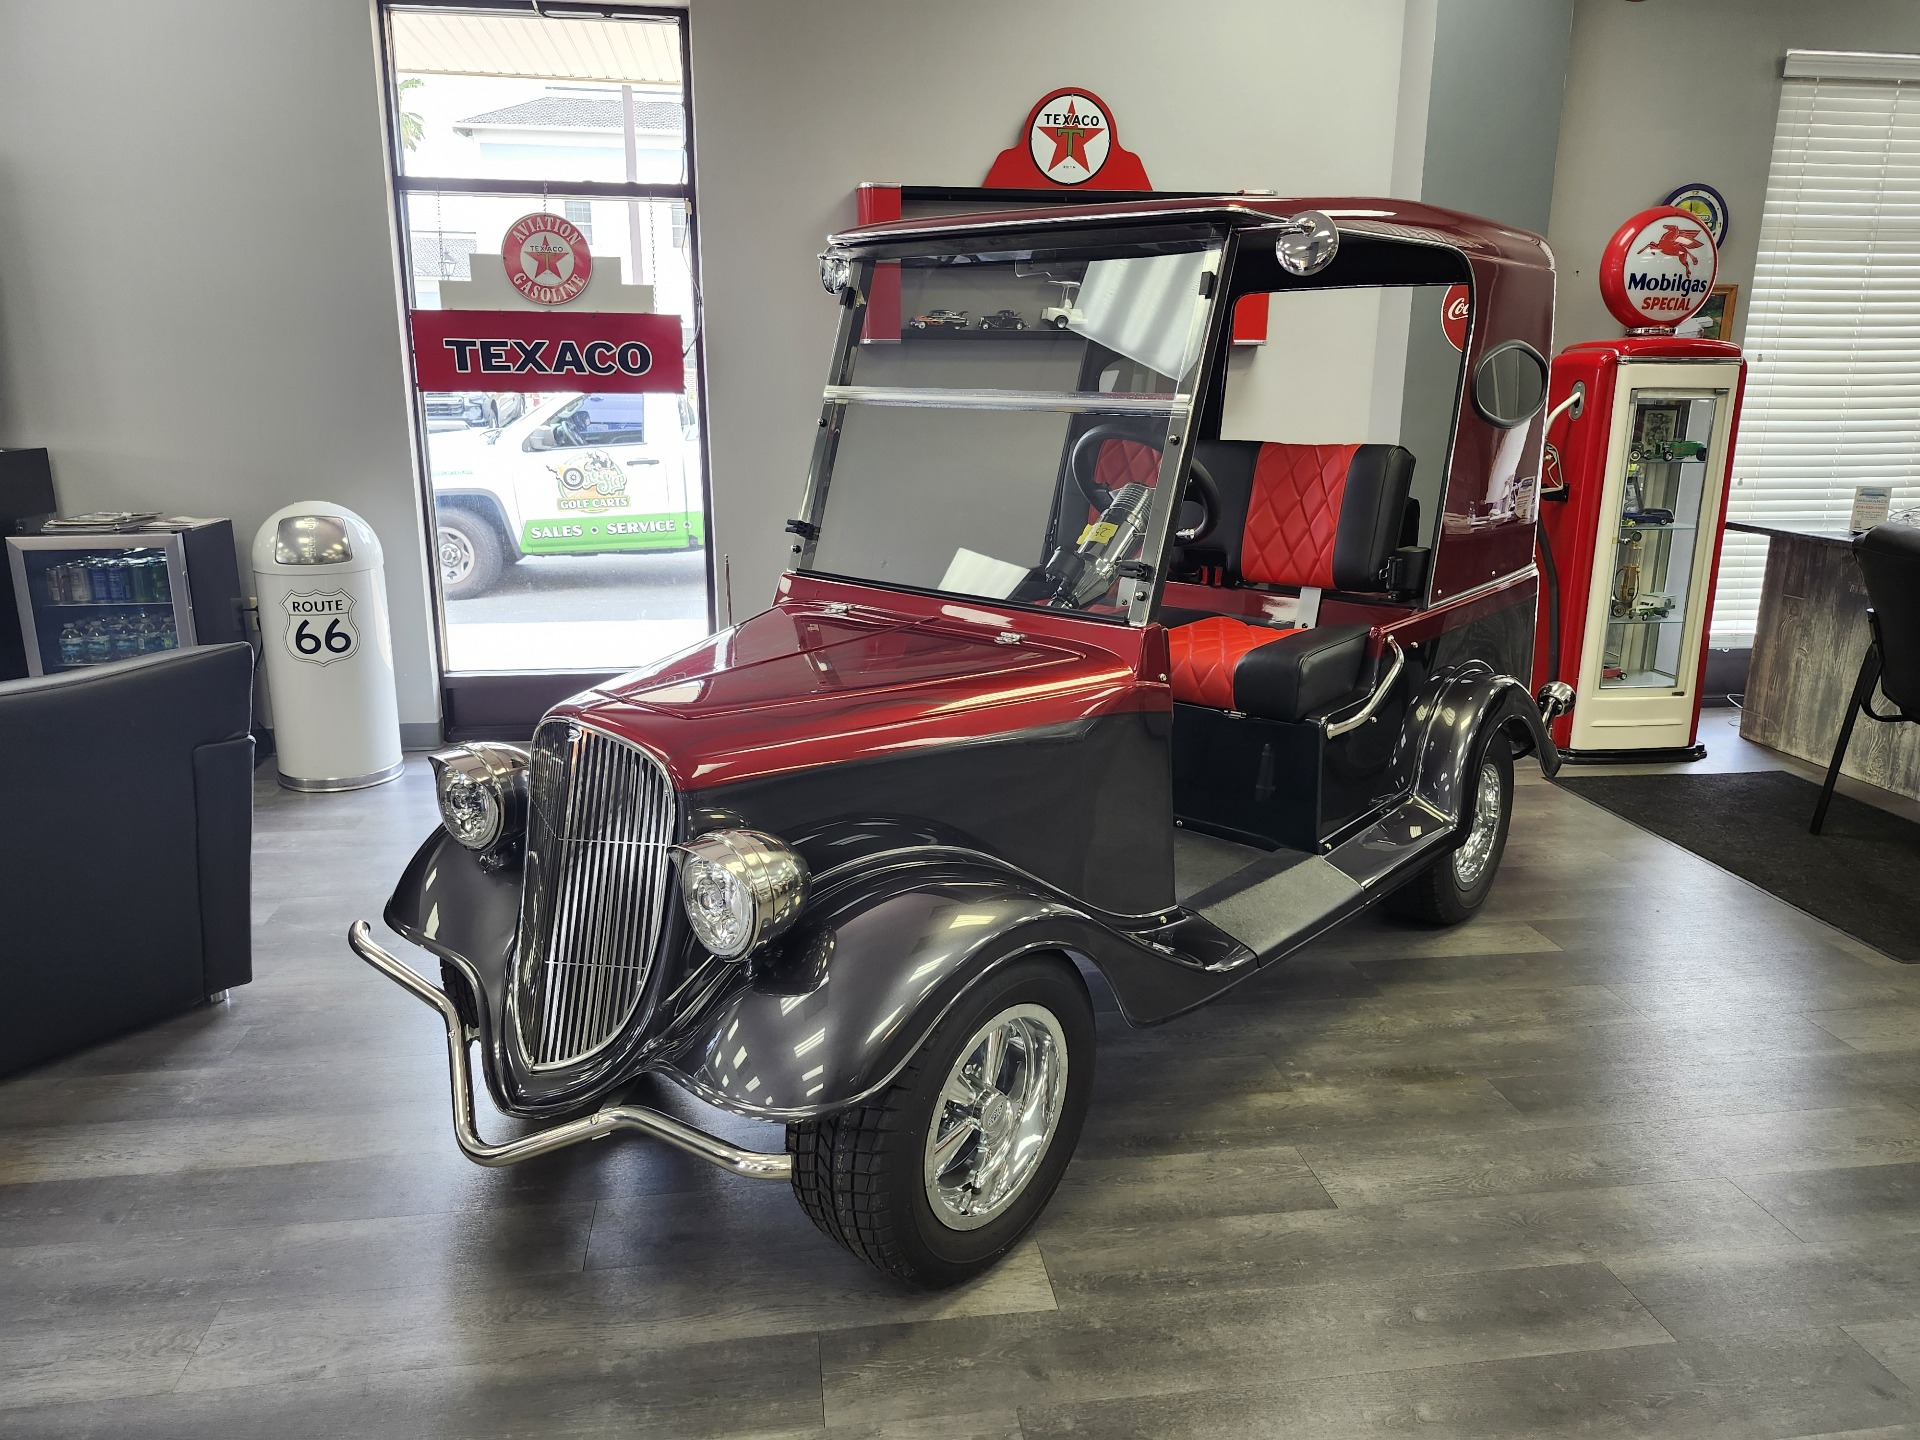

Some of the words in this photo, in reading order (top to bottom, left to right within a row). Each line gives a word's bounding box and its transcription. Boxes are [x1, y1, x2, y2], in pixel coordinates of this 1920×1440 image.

[1044, 113, 1100, 126] TEXACO
[1057, 128, 1085, 157] T
[512, 216, 583, 245] AVIATION
[530, 245, 564, 253] TEXACO
[513, 272, 586, 302] GASOLINE
[1628, 272, 1707, 297] Mobilgas
[1641, 297, 1691, 311] SPECIAL
[443, 338, 653, 376] TEXACO
[560, 499, 589, 509] GOLF
[593, 497, 628, 507] CARTS
[530, 525, 583, 539] SALES
[606, 520, 676, 535] SERVICE
[291, 599, 344, 613] ROUTE
[295, 617, 352, 655] 66
